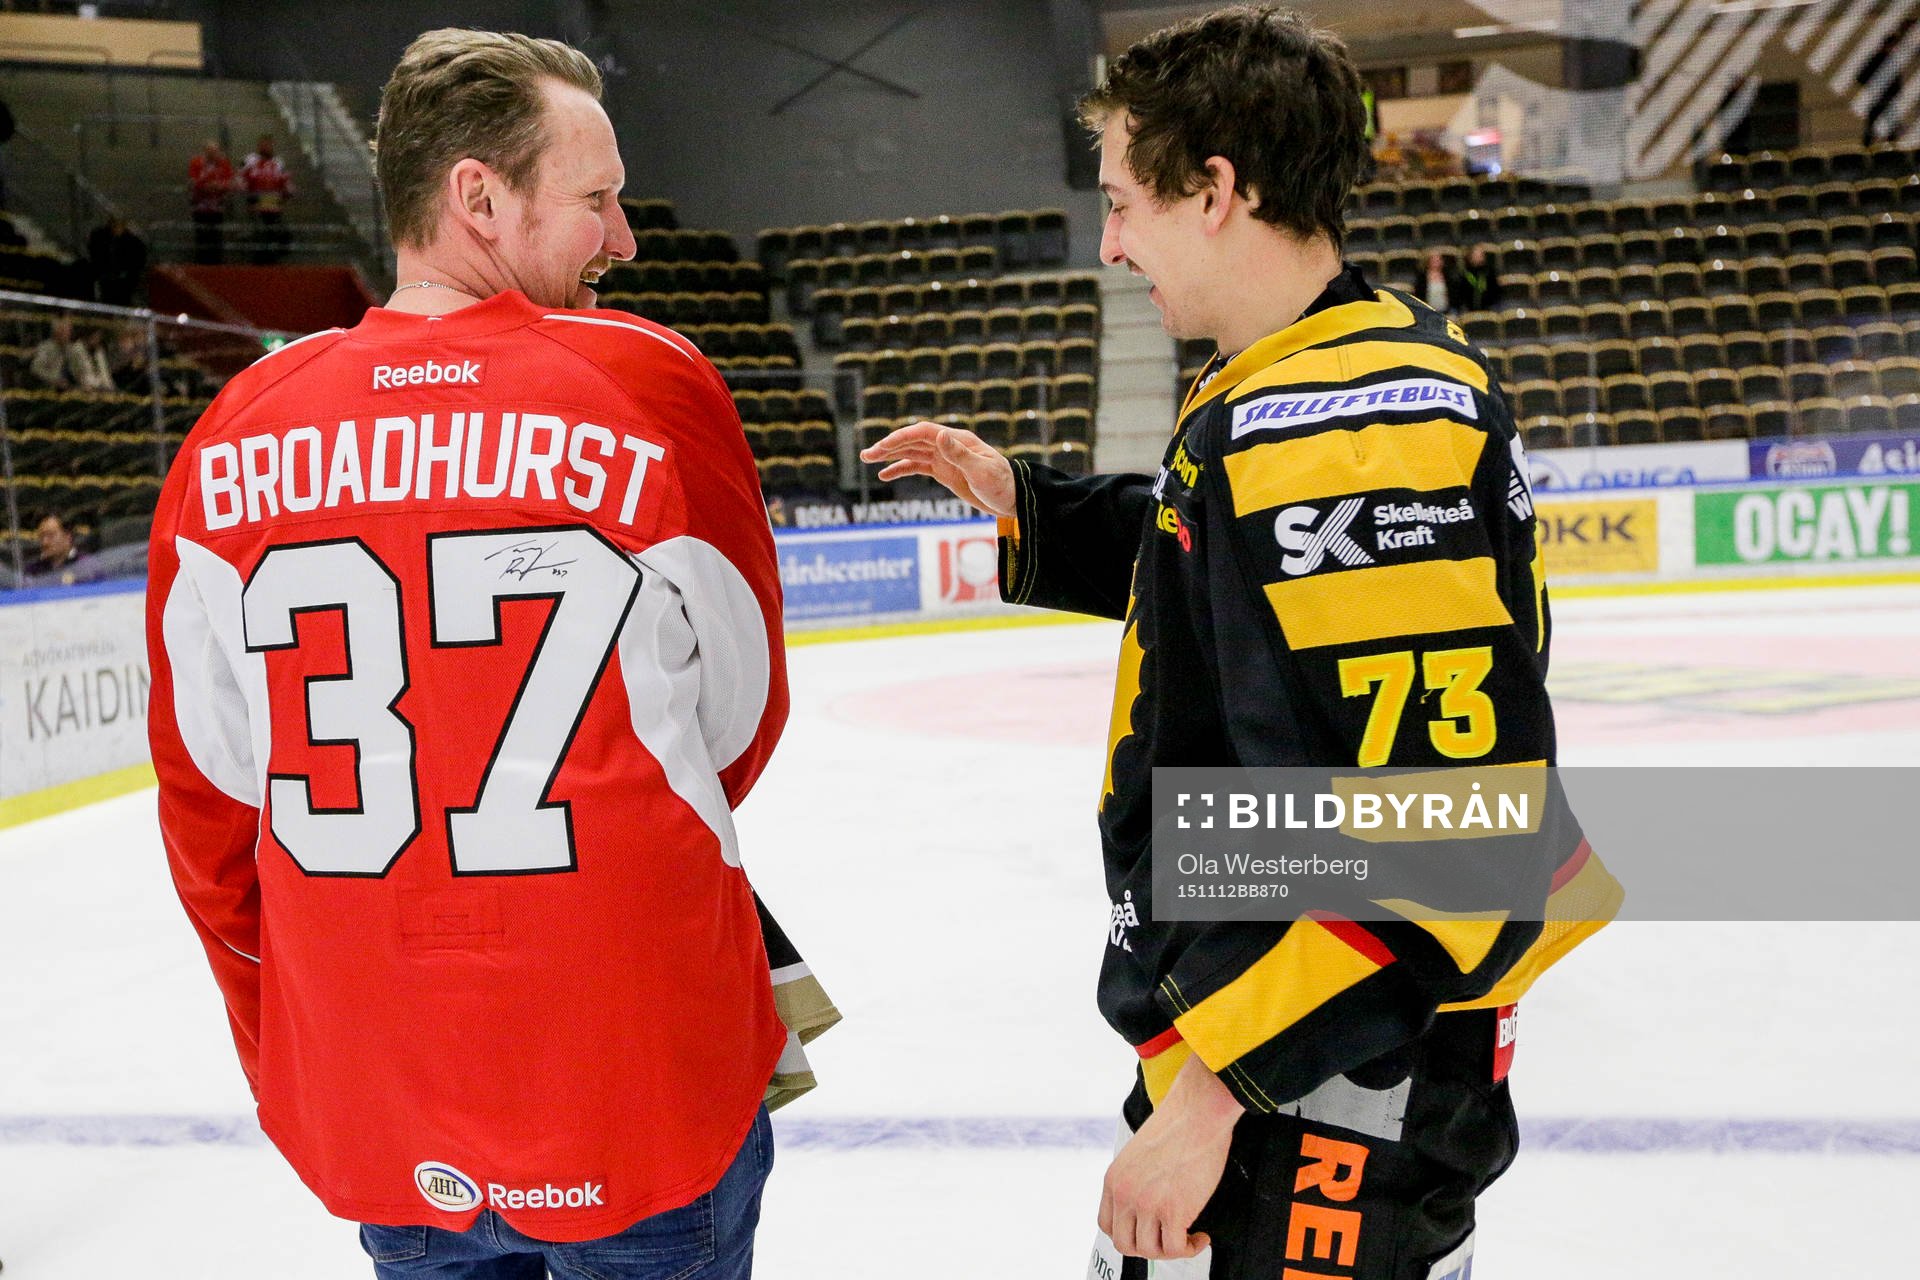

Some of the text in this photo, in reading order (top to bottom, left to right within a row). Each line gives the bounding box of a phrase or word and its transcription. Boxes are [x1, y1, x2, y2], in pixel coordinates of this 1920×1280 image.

[373, 361, 481, 390] Reebok
[1238, 385, 1468, 428] SKELLEFTEBUSS
[200, 412, 667, 532] BROADHURST
[1373, 498, 1476, 527] Skellefteå
[1733, 486, 1913, 562] OCAY!
[1377, 525, 1437, 551] Kraft
[782, 552, 915, 587] årdscenter
[241, 523, 644, 879] 37
[1337, 645, 1498, 769] 73
[428, 1176, 605, 1209] AHL Reebok
[1281, 1132, 1371, 1280] RE
